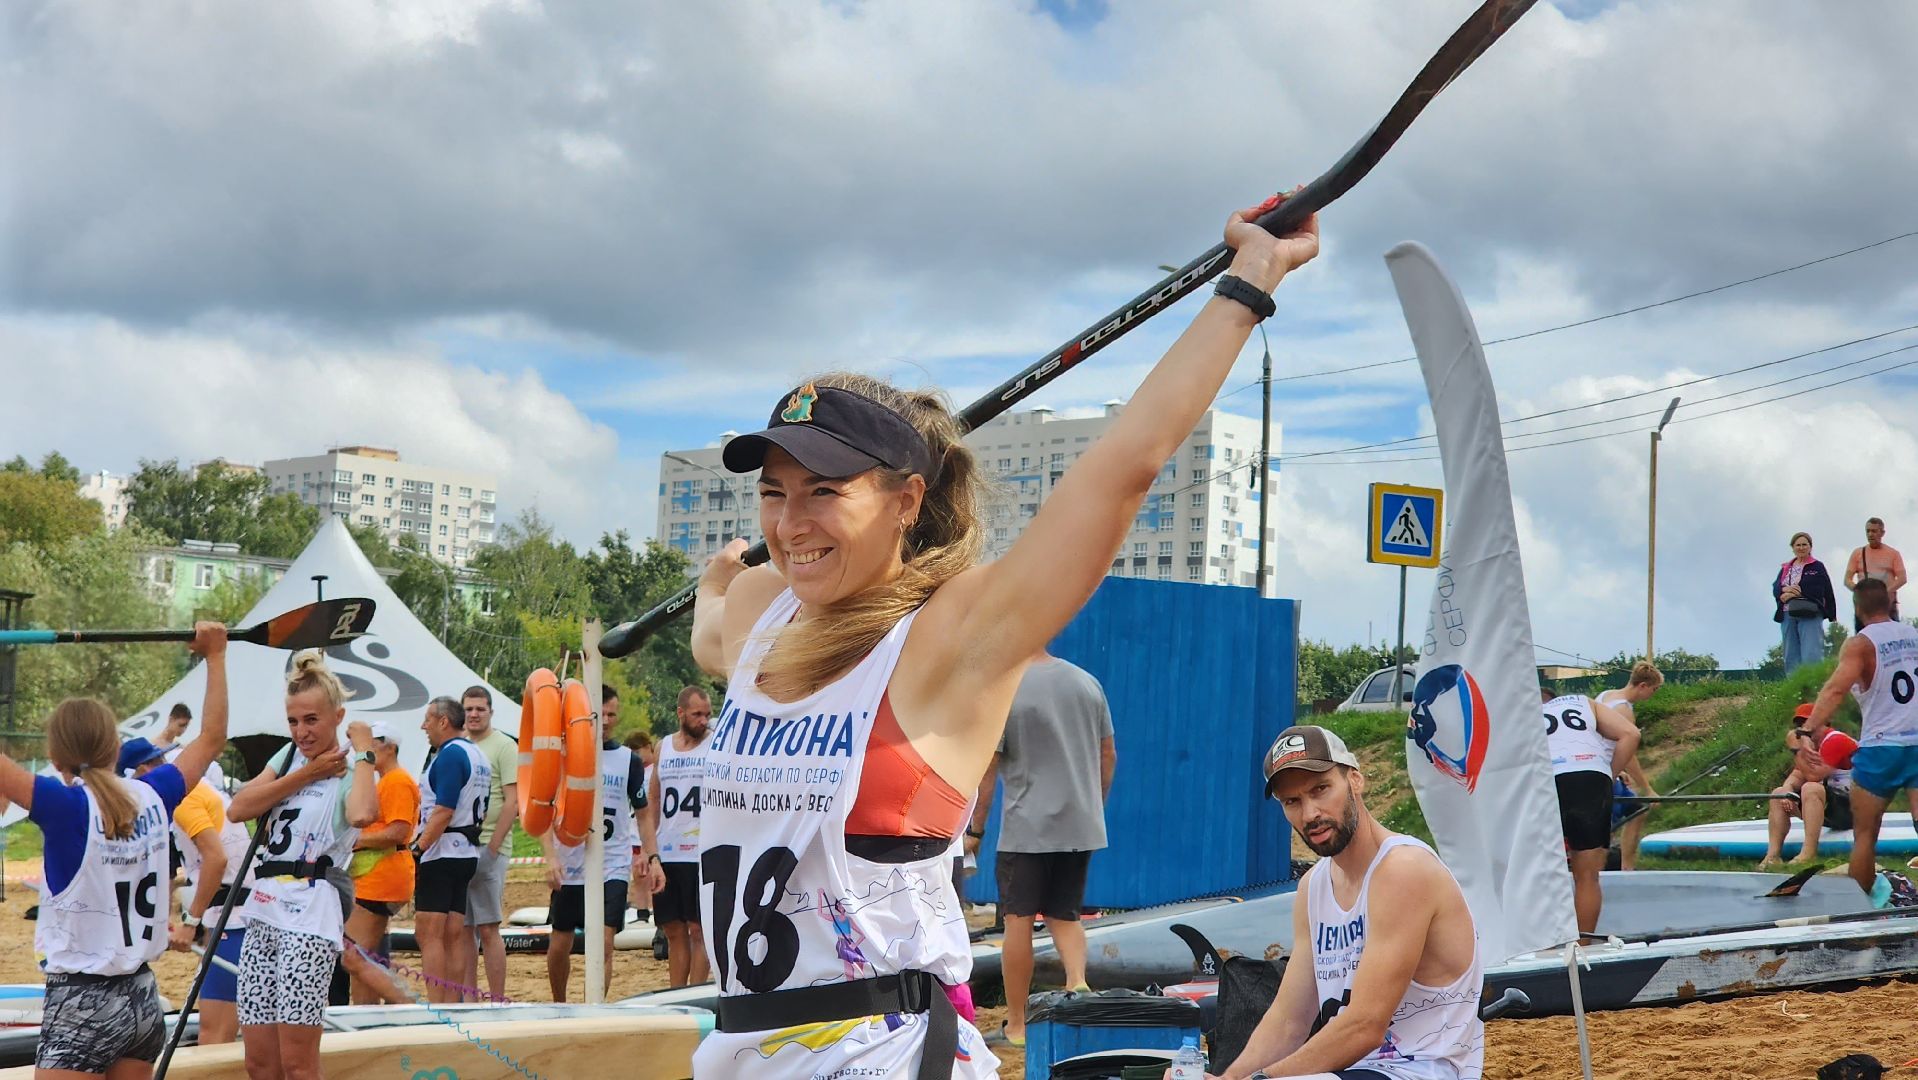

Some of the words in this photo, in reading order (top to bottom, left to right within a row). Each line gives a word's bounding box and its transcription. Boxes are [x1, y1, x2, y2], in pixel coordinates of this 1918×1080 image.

[736, 767, 783, 783] ОБЛАСТИ
[786, 767, 800, 783] ПО
[806, 767, 844, 785] СЕРФ
[663, 786, 702, 819] 04
[752, 793, 791, 814] ДОСКА
[795, 794, 803, 812] С
[702, 844, 800, 994] 18
[47, 974, 69, 984] PRO
